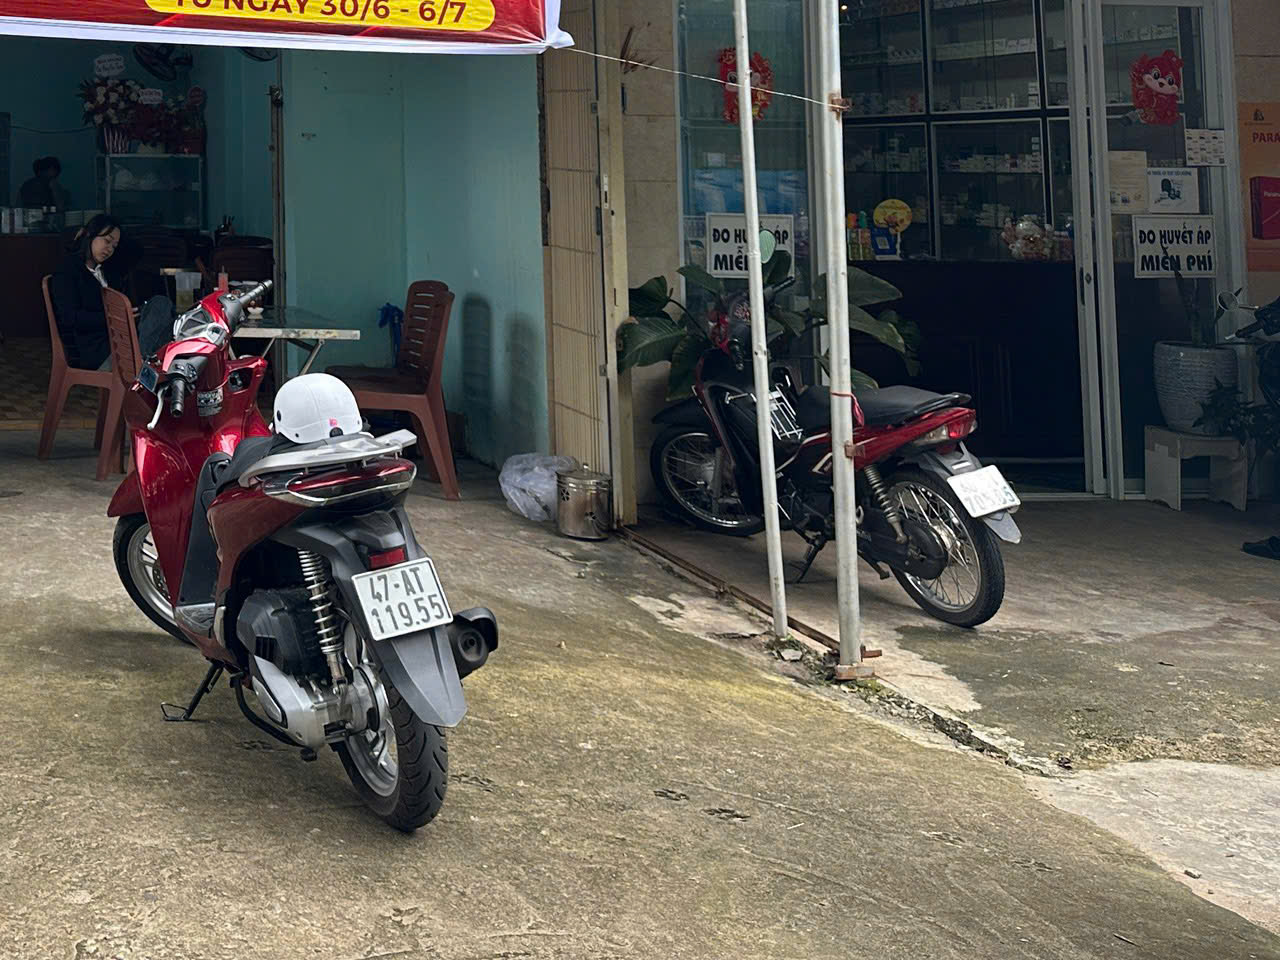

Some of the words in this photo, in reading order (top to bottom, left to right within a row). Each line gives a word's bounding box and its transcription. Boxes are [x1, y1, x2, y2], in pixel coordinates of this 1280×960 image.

[712, 228, 730, 243] ĐO
[1139, 229, 1156, 244] ĐO
[1160, 222, 1193, 245] HUYẾT
[1196, 225, 1211, 245] ÁP
[714, 246, 748, 271] MIỄ
[1186, 250, 1213, 271] PHÍ
[369, 567, 425, 602] 47-AT
[371, 593, 444, 634] 119.55
